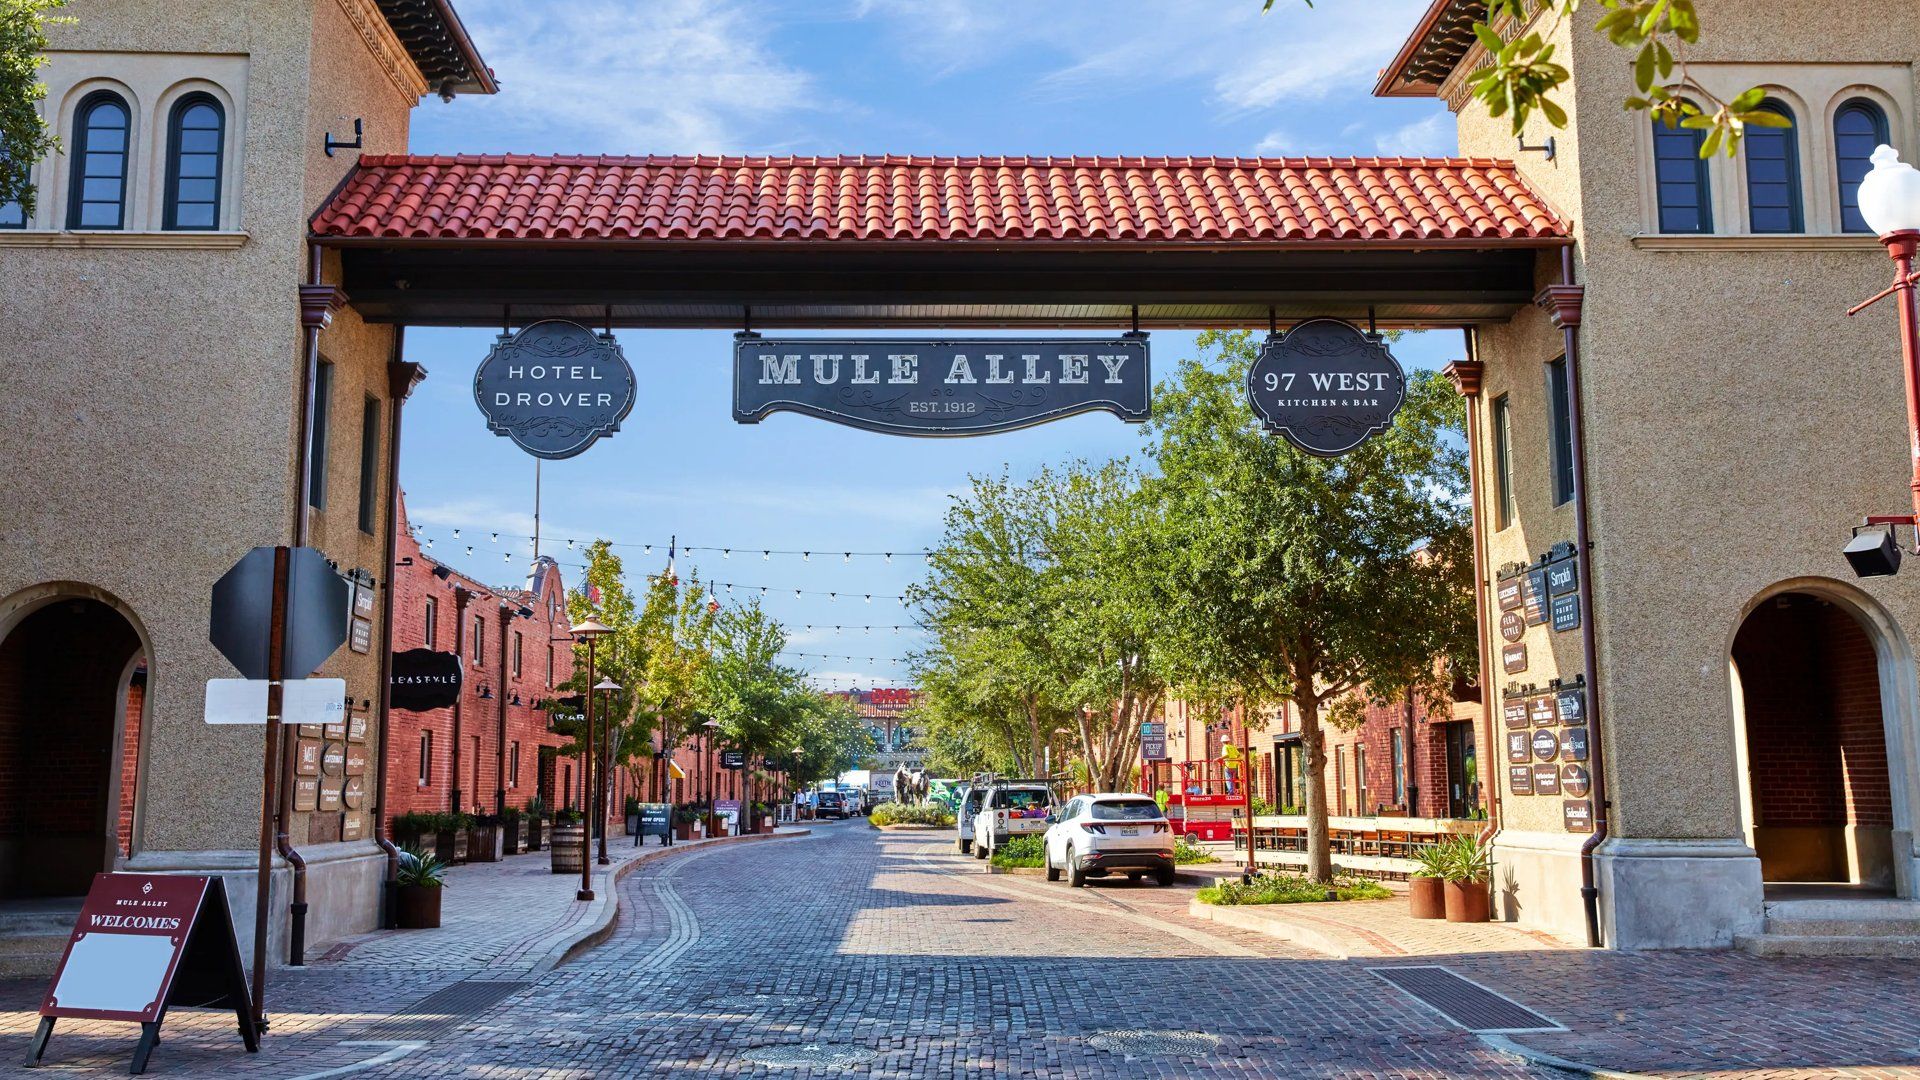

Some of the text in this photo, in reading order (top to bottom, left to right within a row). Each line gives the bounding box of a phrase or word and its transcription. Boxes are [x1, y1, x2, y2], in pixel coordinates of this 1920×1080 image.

[509, 365, 603, 380] HOTEL
[758, 354, 1129, 385] MULE ALLEY
[1264, 372, 1390, 392] 97 WEST
[495, 392, 612, 406] DROVER
[1278, 399, 1379, 407] KITCHEN & BAR
[909, 401, 976, 413] EST. 1912
[1503, 625, 1519, 637] STYLE
[91, 914, 181, 930] WELCOMES
